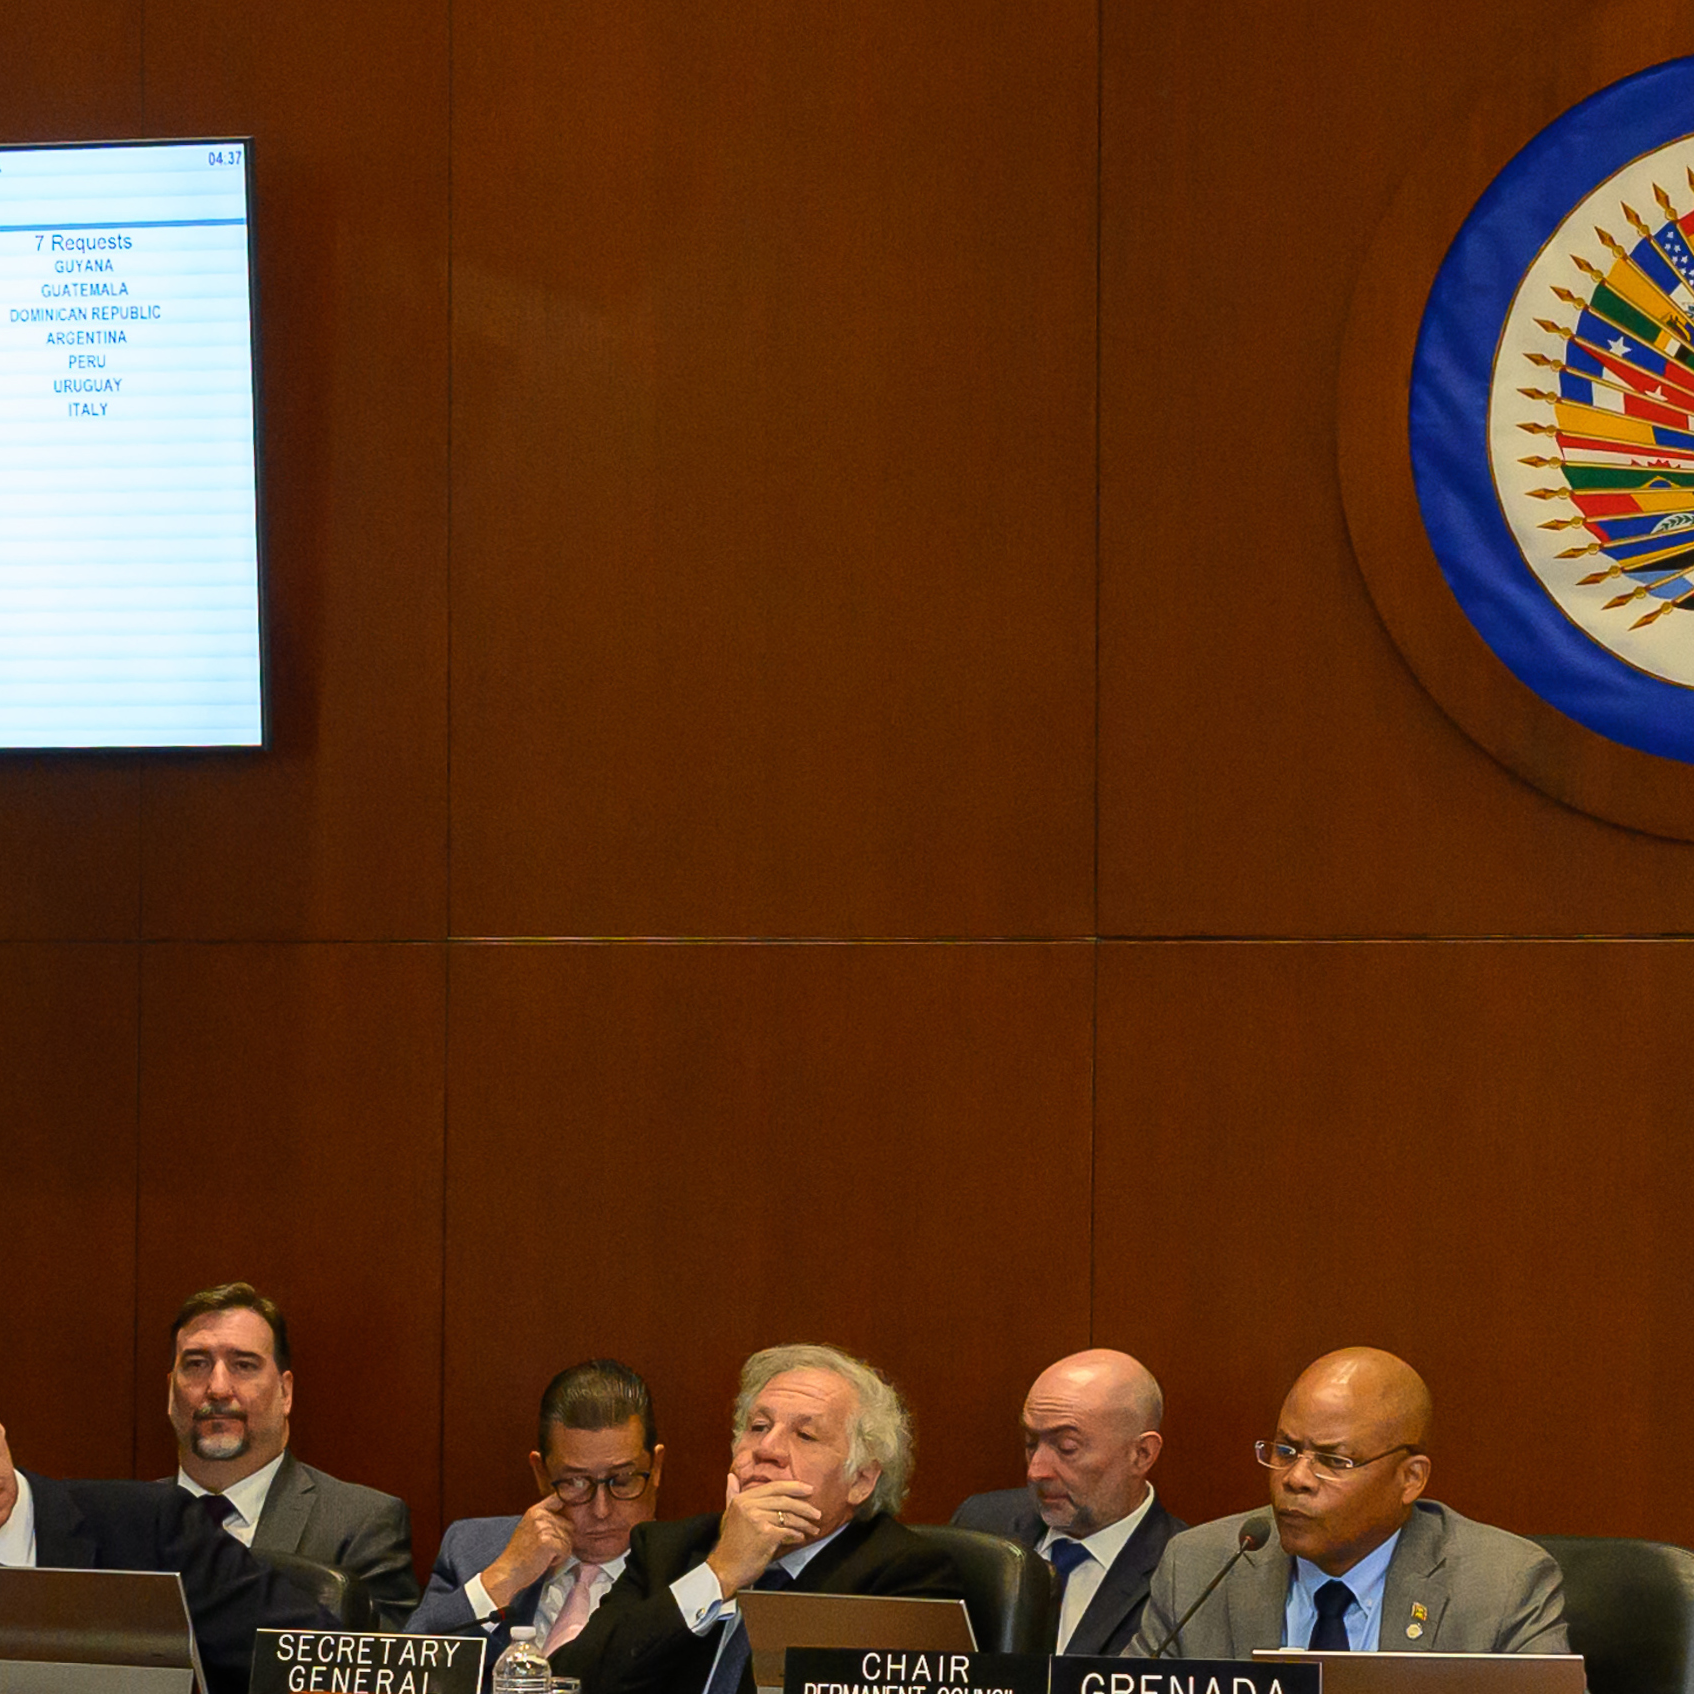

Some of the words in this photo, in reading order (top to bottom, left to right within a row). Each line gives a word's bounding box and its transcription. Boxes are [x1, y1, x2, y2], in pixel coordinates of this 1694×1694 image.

[208, 151, 242, 166] 04:37
[35, 235, 45, 252] 7
[51, 233, 133, 253] Requests
[54, 259, 114, 273] GUYANA
[41, 282, 129, 298] GUATEMALA
[10, 307, 87, 323] DOMINICAN
[92, 305, 161, 320] REPUBLIC
[46, 330, 127, 345] ARGENTINA
[69, 355, 106, 369] PERU
[54, 378, 122, 393] URUGUAY
[69, 403, 108, 417] ITALY
[276, 1634, 461, 1668] SECRETARY
[862, 1652, 970, 1684] CHAIR
